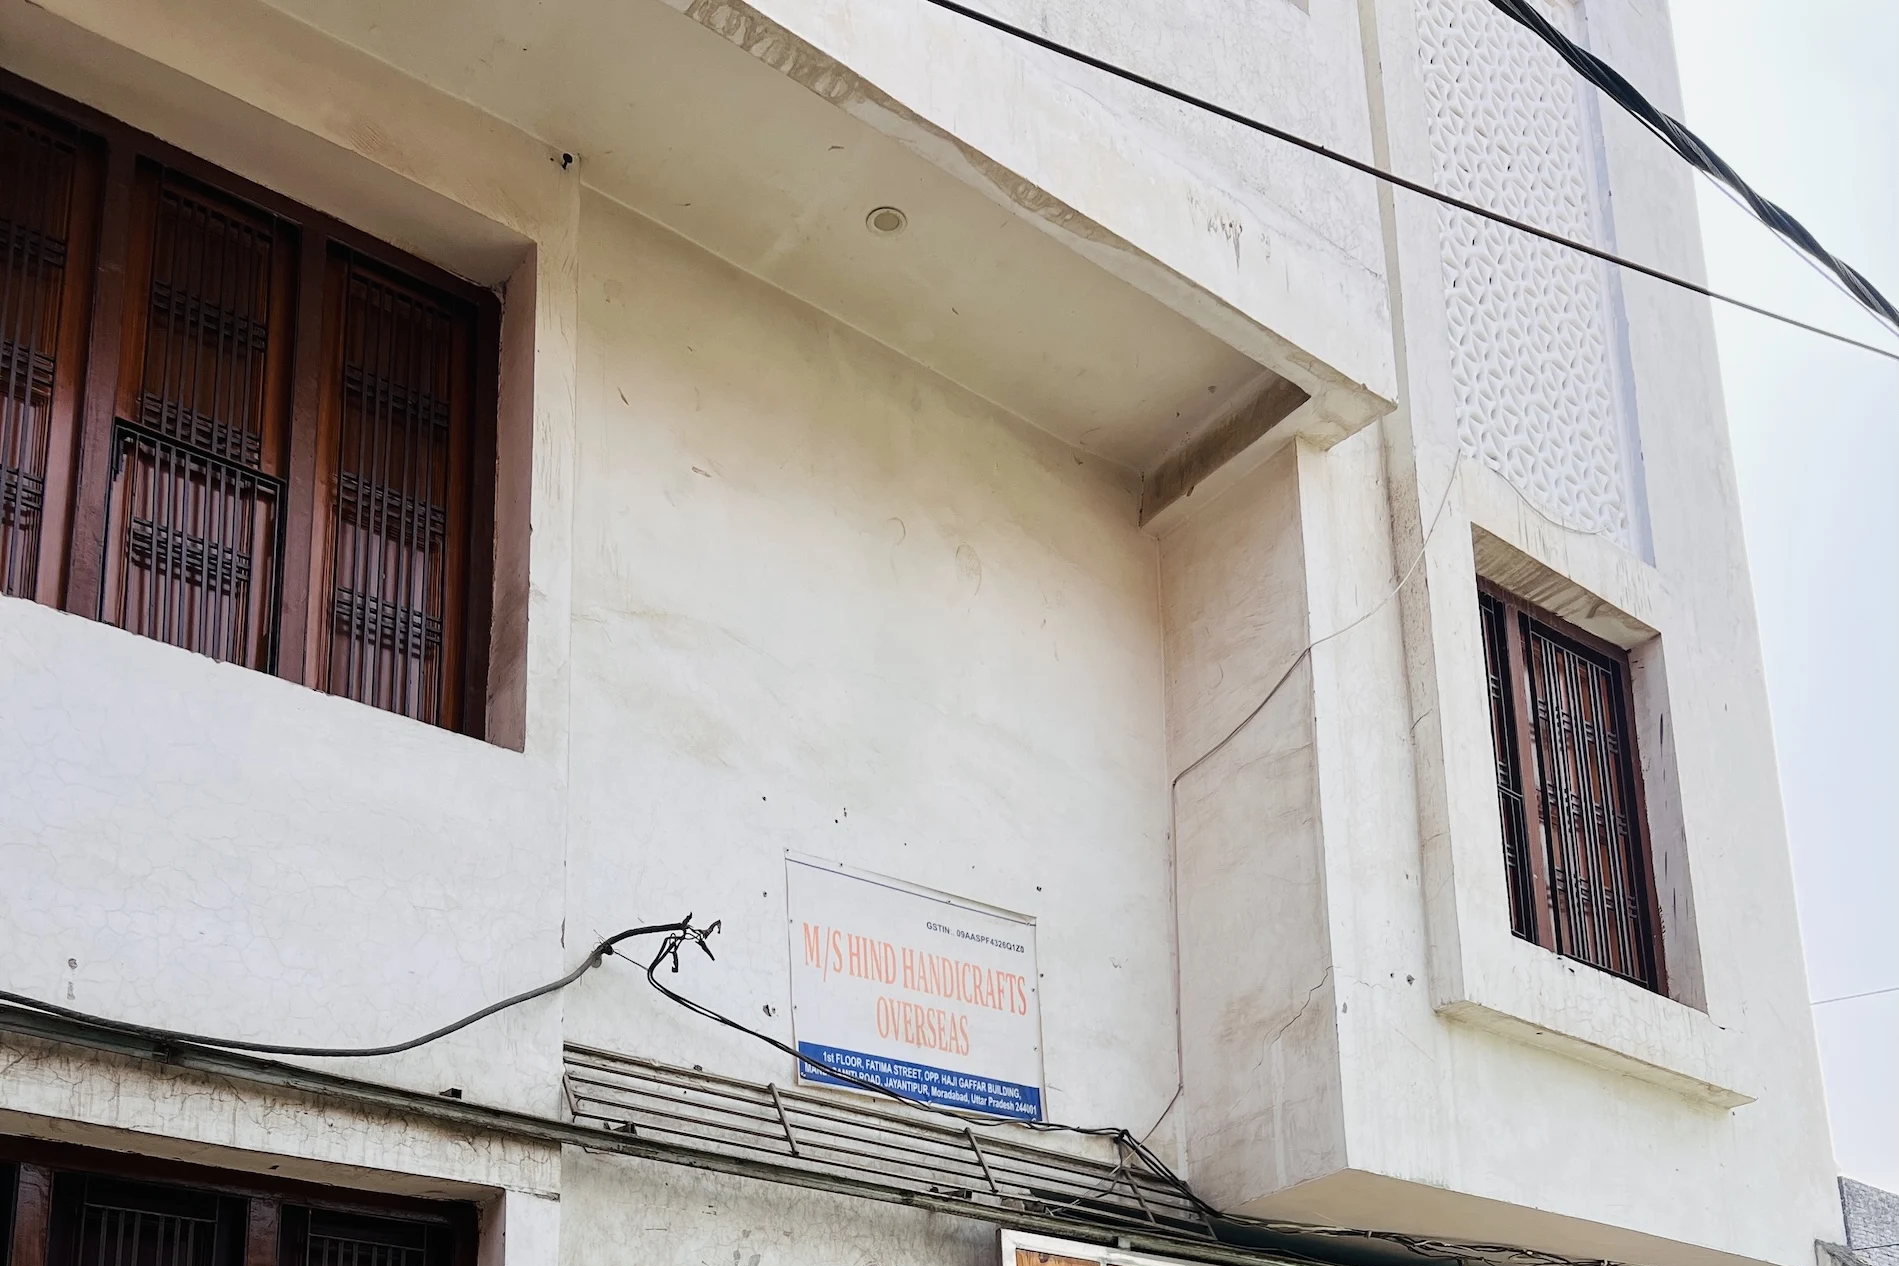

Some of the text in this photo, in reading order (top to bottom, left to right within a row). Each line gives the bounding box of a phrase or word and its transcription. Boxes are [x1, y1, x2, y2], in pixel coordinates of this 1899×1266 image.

[802, 922, 1027, 1016] M/S HIND HANDICRAFTS
[876, 996, 970, 1057] OVERSEAS
[823, 1051, 1021, 1100] 1st FLOOR, FATIMA STREET, OPP. HAJI GAFFAR BUILDING,
[884, 1077, 930, 1096] JAYANTIPUR,
[931, 1086, 970, 1104] Moradabad,
[971, 1094, 987, 1105] Uttar
[988, 1097, 1014, 1111] Pradesh
